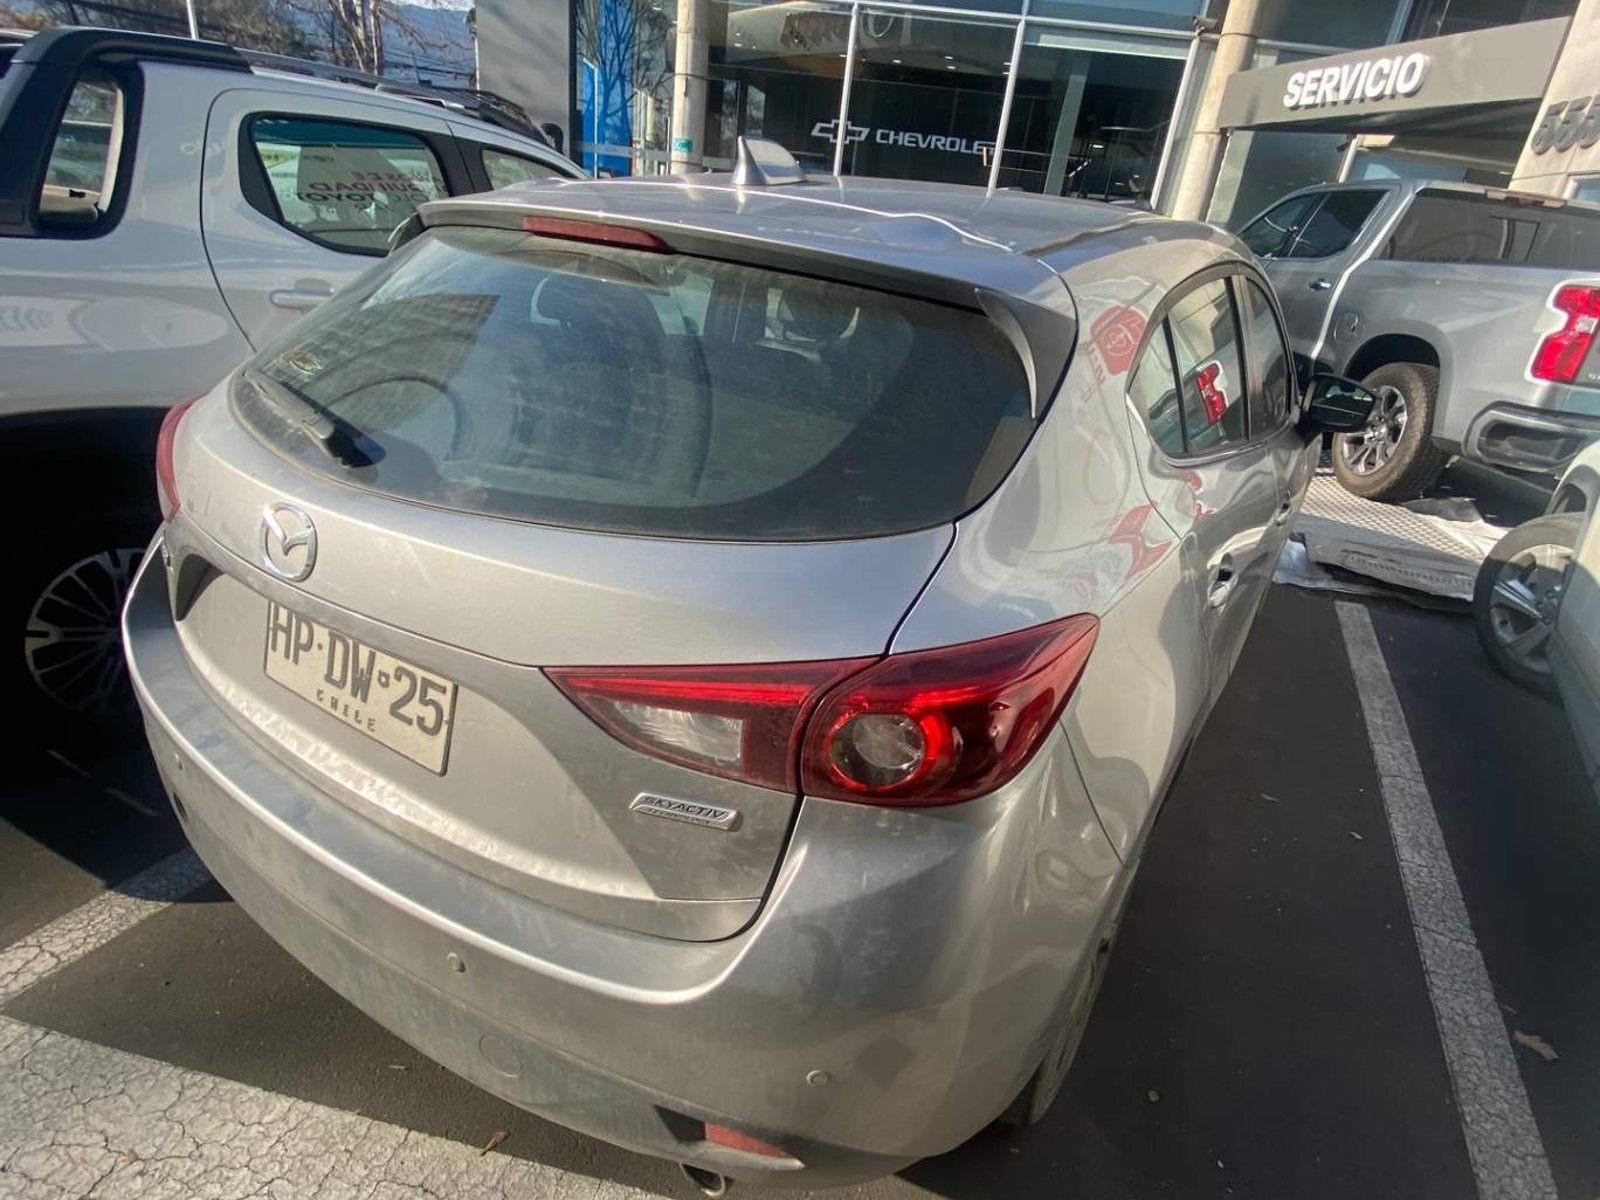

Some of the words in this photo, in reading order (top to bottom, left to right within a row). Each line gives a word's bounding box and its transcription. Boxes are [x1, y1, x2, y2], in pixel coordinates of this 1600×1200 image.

[1283, 52, 1428, 108] SERVICIO
[316, 688, 377, 732] CHILE
[642, 796, 726, 818] SKYACTIV
